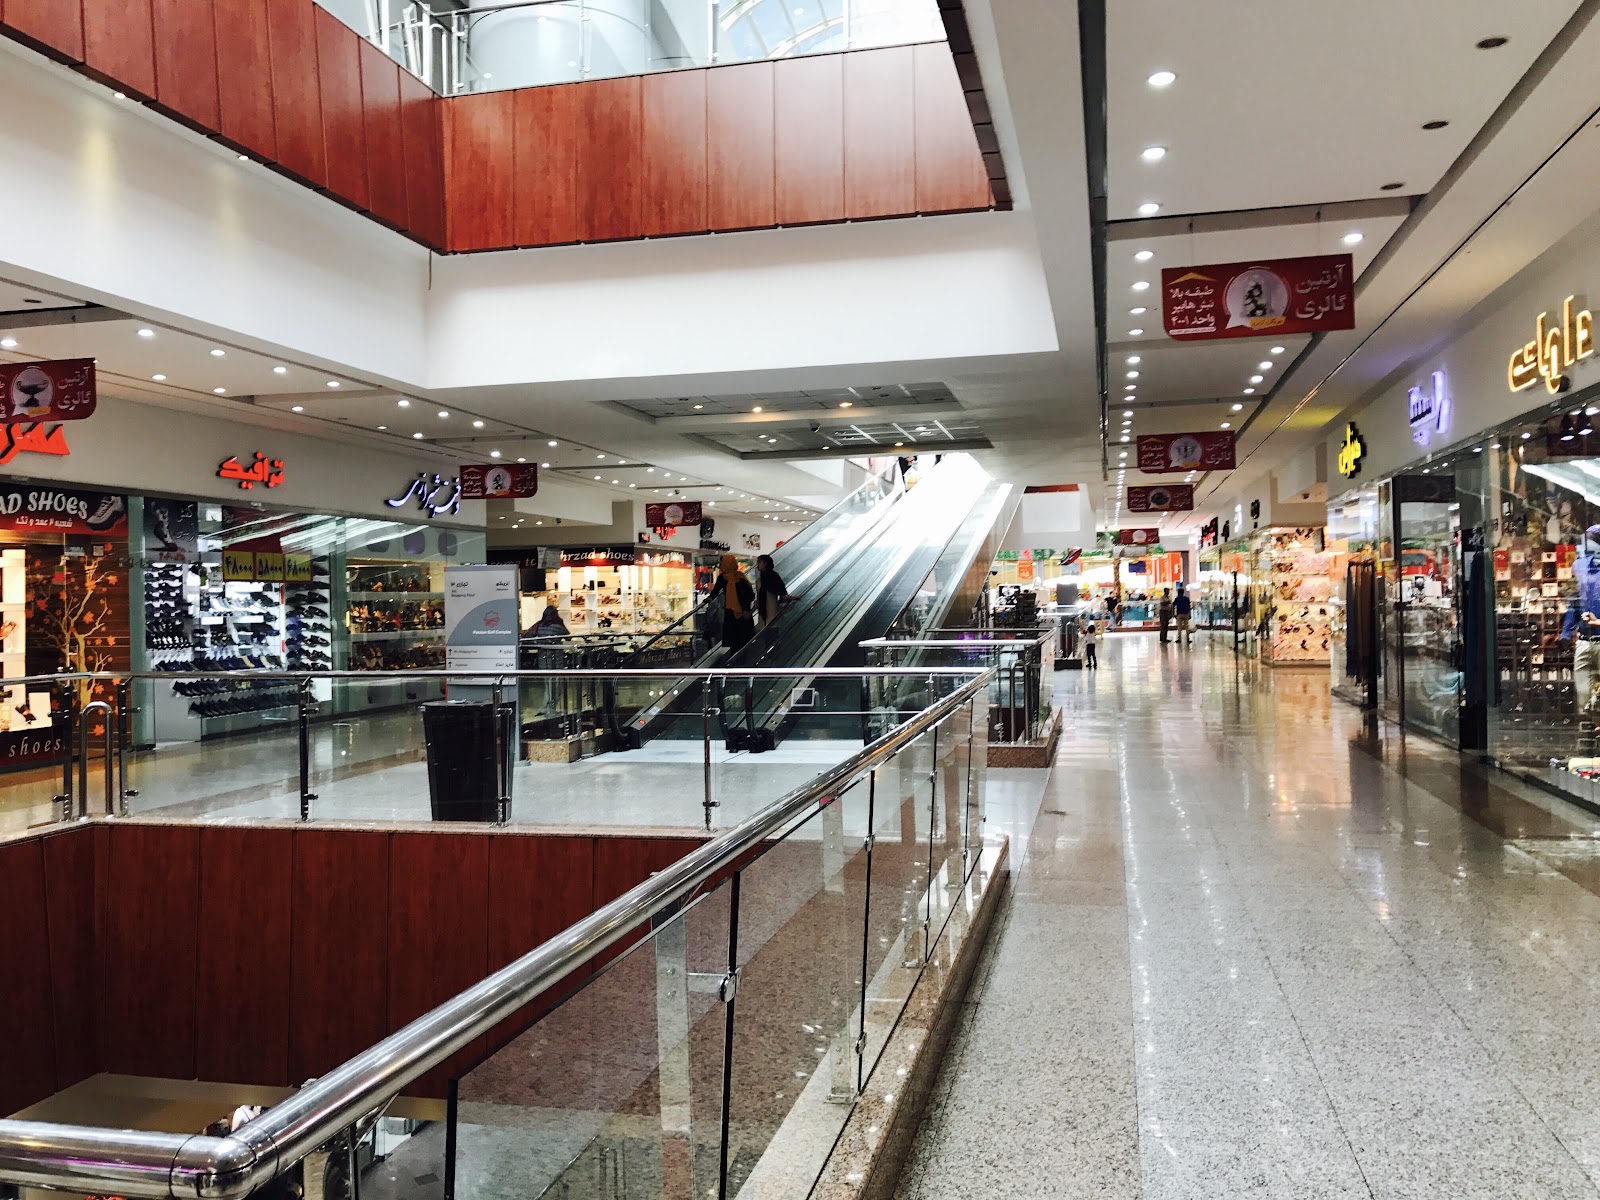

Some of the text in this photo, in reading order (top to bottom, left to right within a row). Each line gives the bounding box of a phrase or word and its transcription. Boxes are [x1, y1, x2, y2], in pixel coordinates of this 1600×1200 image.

[1296, 264, 1346, 294] آرتین
[1170, 285, 1214, 299] طبقه بالا
[1296, 294, 1347, 320] گالری
[1191, 313, 1215, 327] واحد
[57, 391, 91, 411] گالری
[219, 451, 285, 489] ترافیک
[27, 491, 88, 519] SHOES
[599, 547, 635, 562] shoes
[8, 736, 61, 758] shoes
